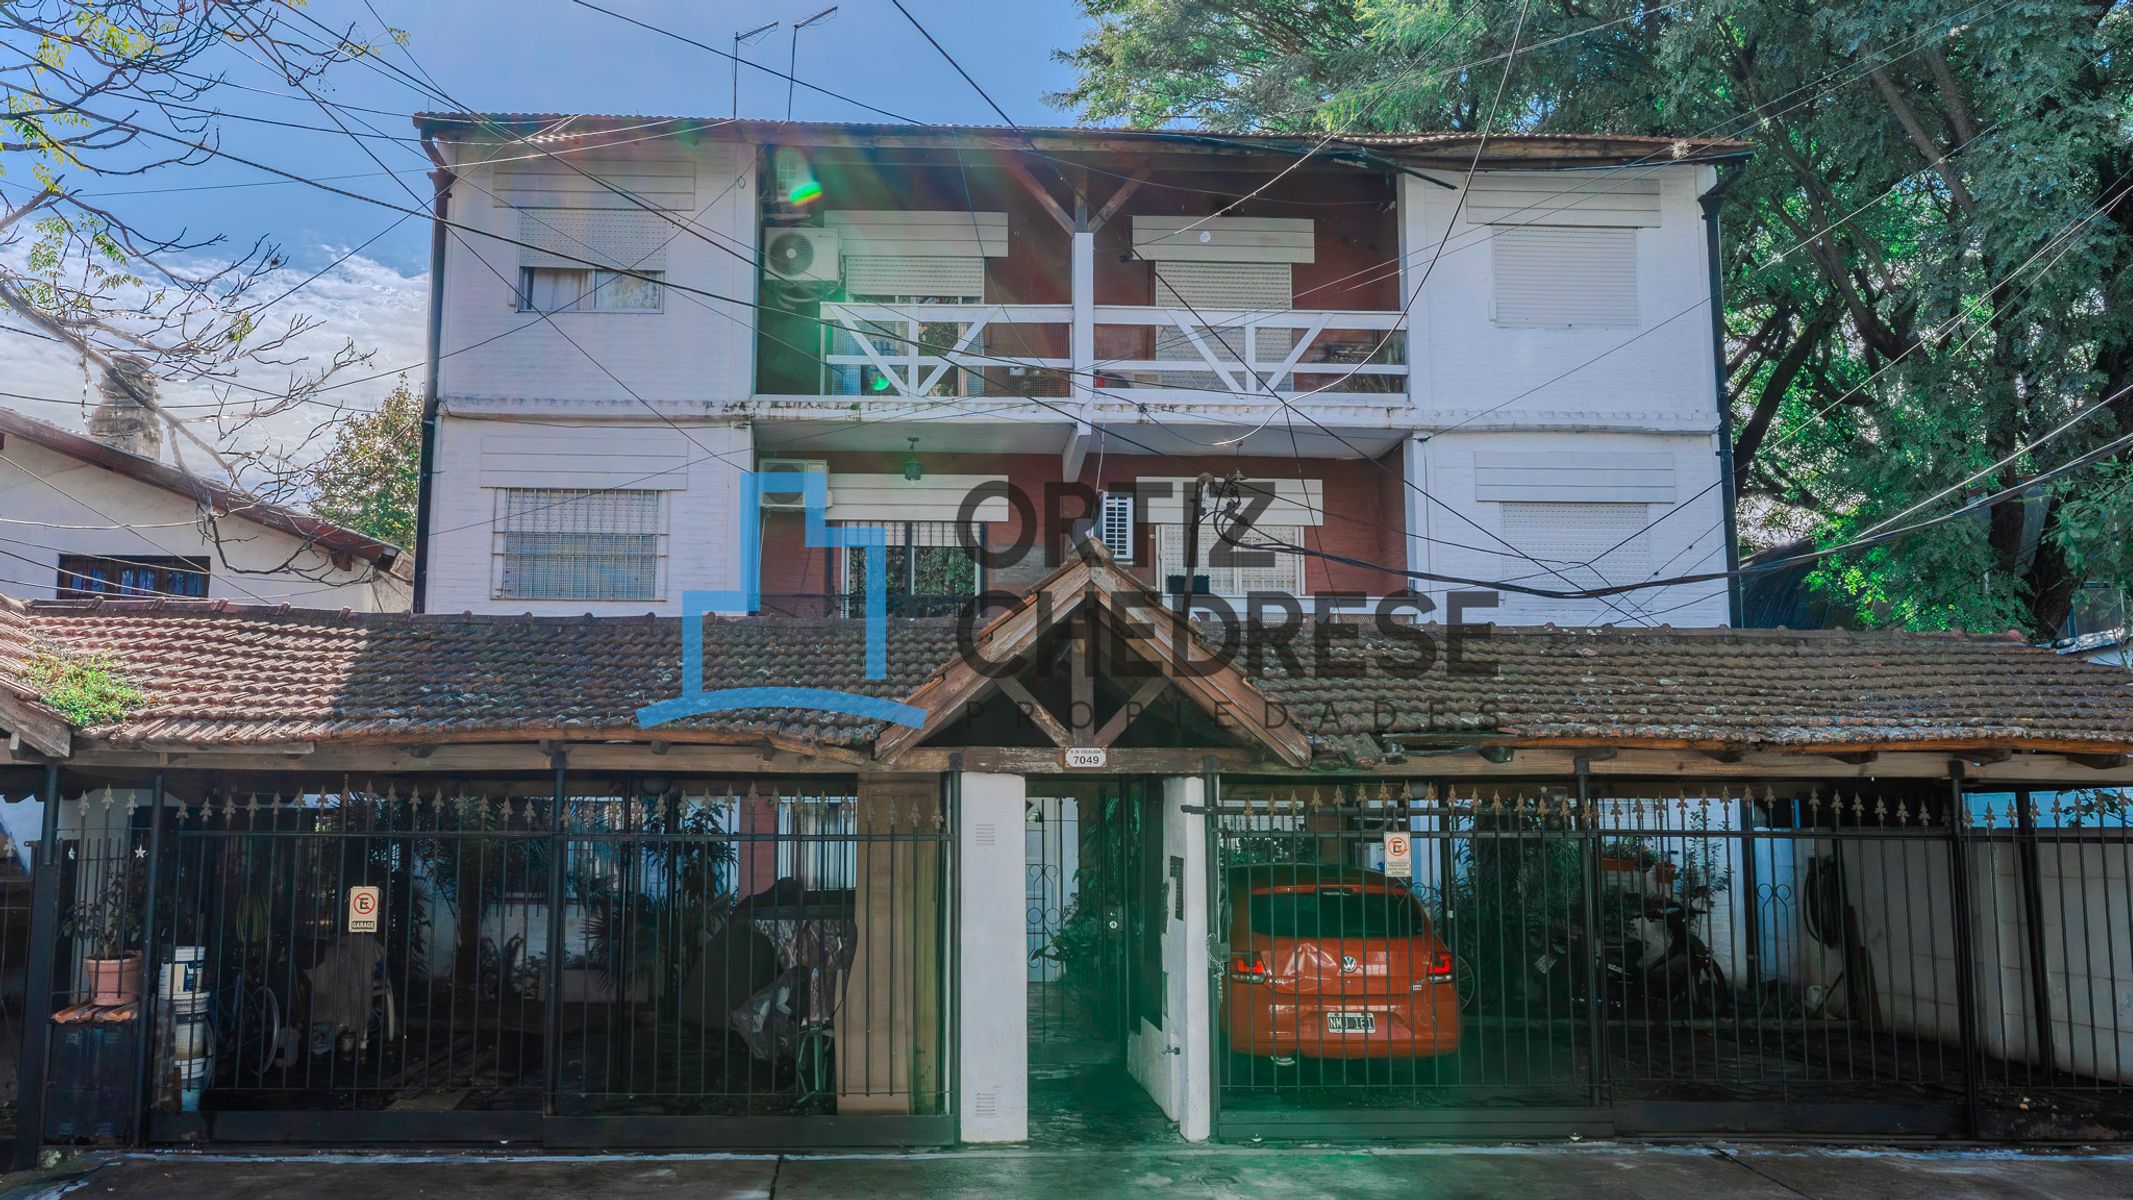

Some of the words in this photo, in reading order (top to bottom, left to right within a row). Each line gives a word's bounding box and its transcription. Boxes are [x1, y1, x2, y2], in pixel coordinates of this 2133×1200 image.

[1073, 755, 1099, 765] 7049
[360, 898, 369, 909] E
[352, 921, 374, 929] GARAGE
